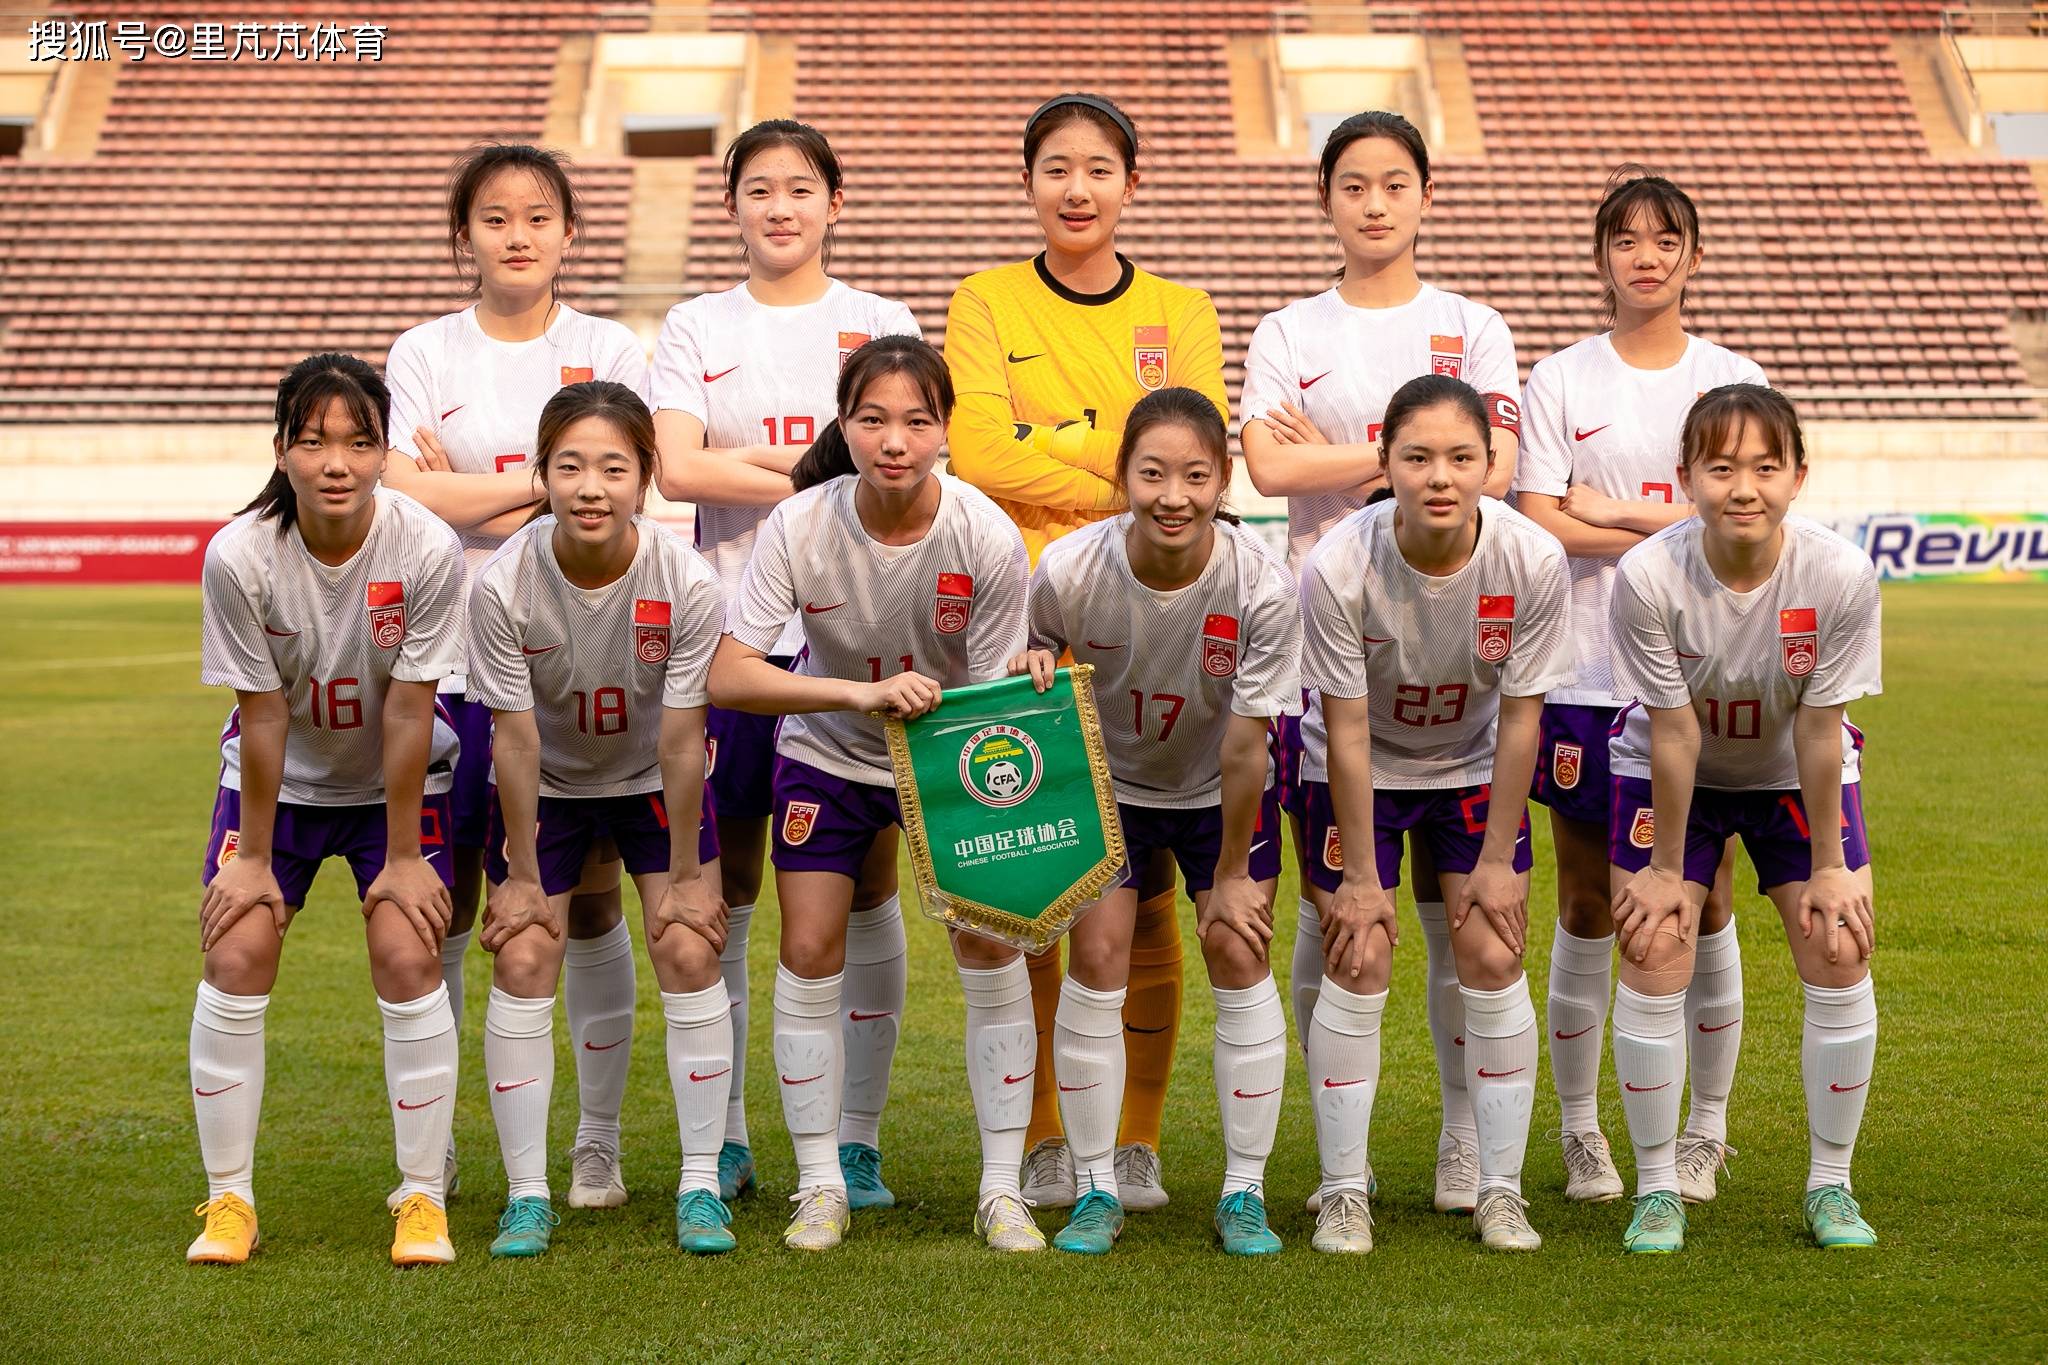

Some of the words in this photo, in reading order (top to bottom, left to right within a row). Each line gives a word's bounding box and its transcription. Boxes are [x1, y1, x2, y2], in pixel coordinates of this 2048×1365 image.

[1139, 352, 1163, 360] CFA
[1435, 359, 1458, 369] CFA
[375, 610, 400, 622] CFA
[1482, 625, 1507, 633] CFA
[1208, 642, 1232, 653] CFA
[1787, 640, 1812, 648] CFA
[310, 676, 364, 731] 16
[1393, 684, 1468, 727] 23
[572, 687, 628, 736] 18
[1130, 689, 1185, 742] 17
[1705, 698, 1761, 739] 10
[1558, 748, 1578, 759] CFA
[993, 774, 1016, 786] CFA
[791, 805, 814, 815] CFA
[954, 818, 1078, 858] 中国足球协会
[957, 856, 989, 868] CHINESE
[991, 849, 1029, 862] FOOTBALL
[1032, 838, 1080, 854] ASSOCIATION
